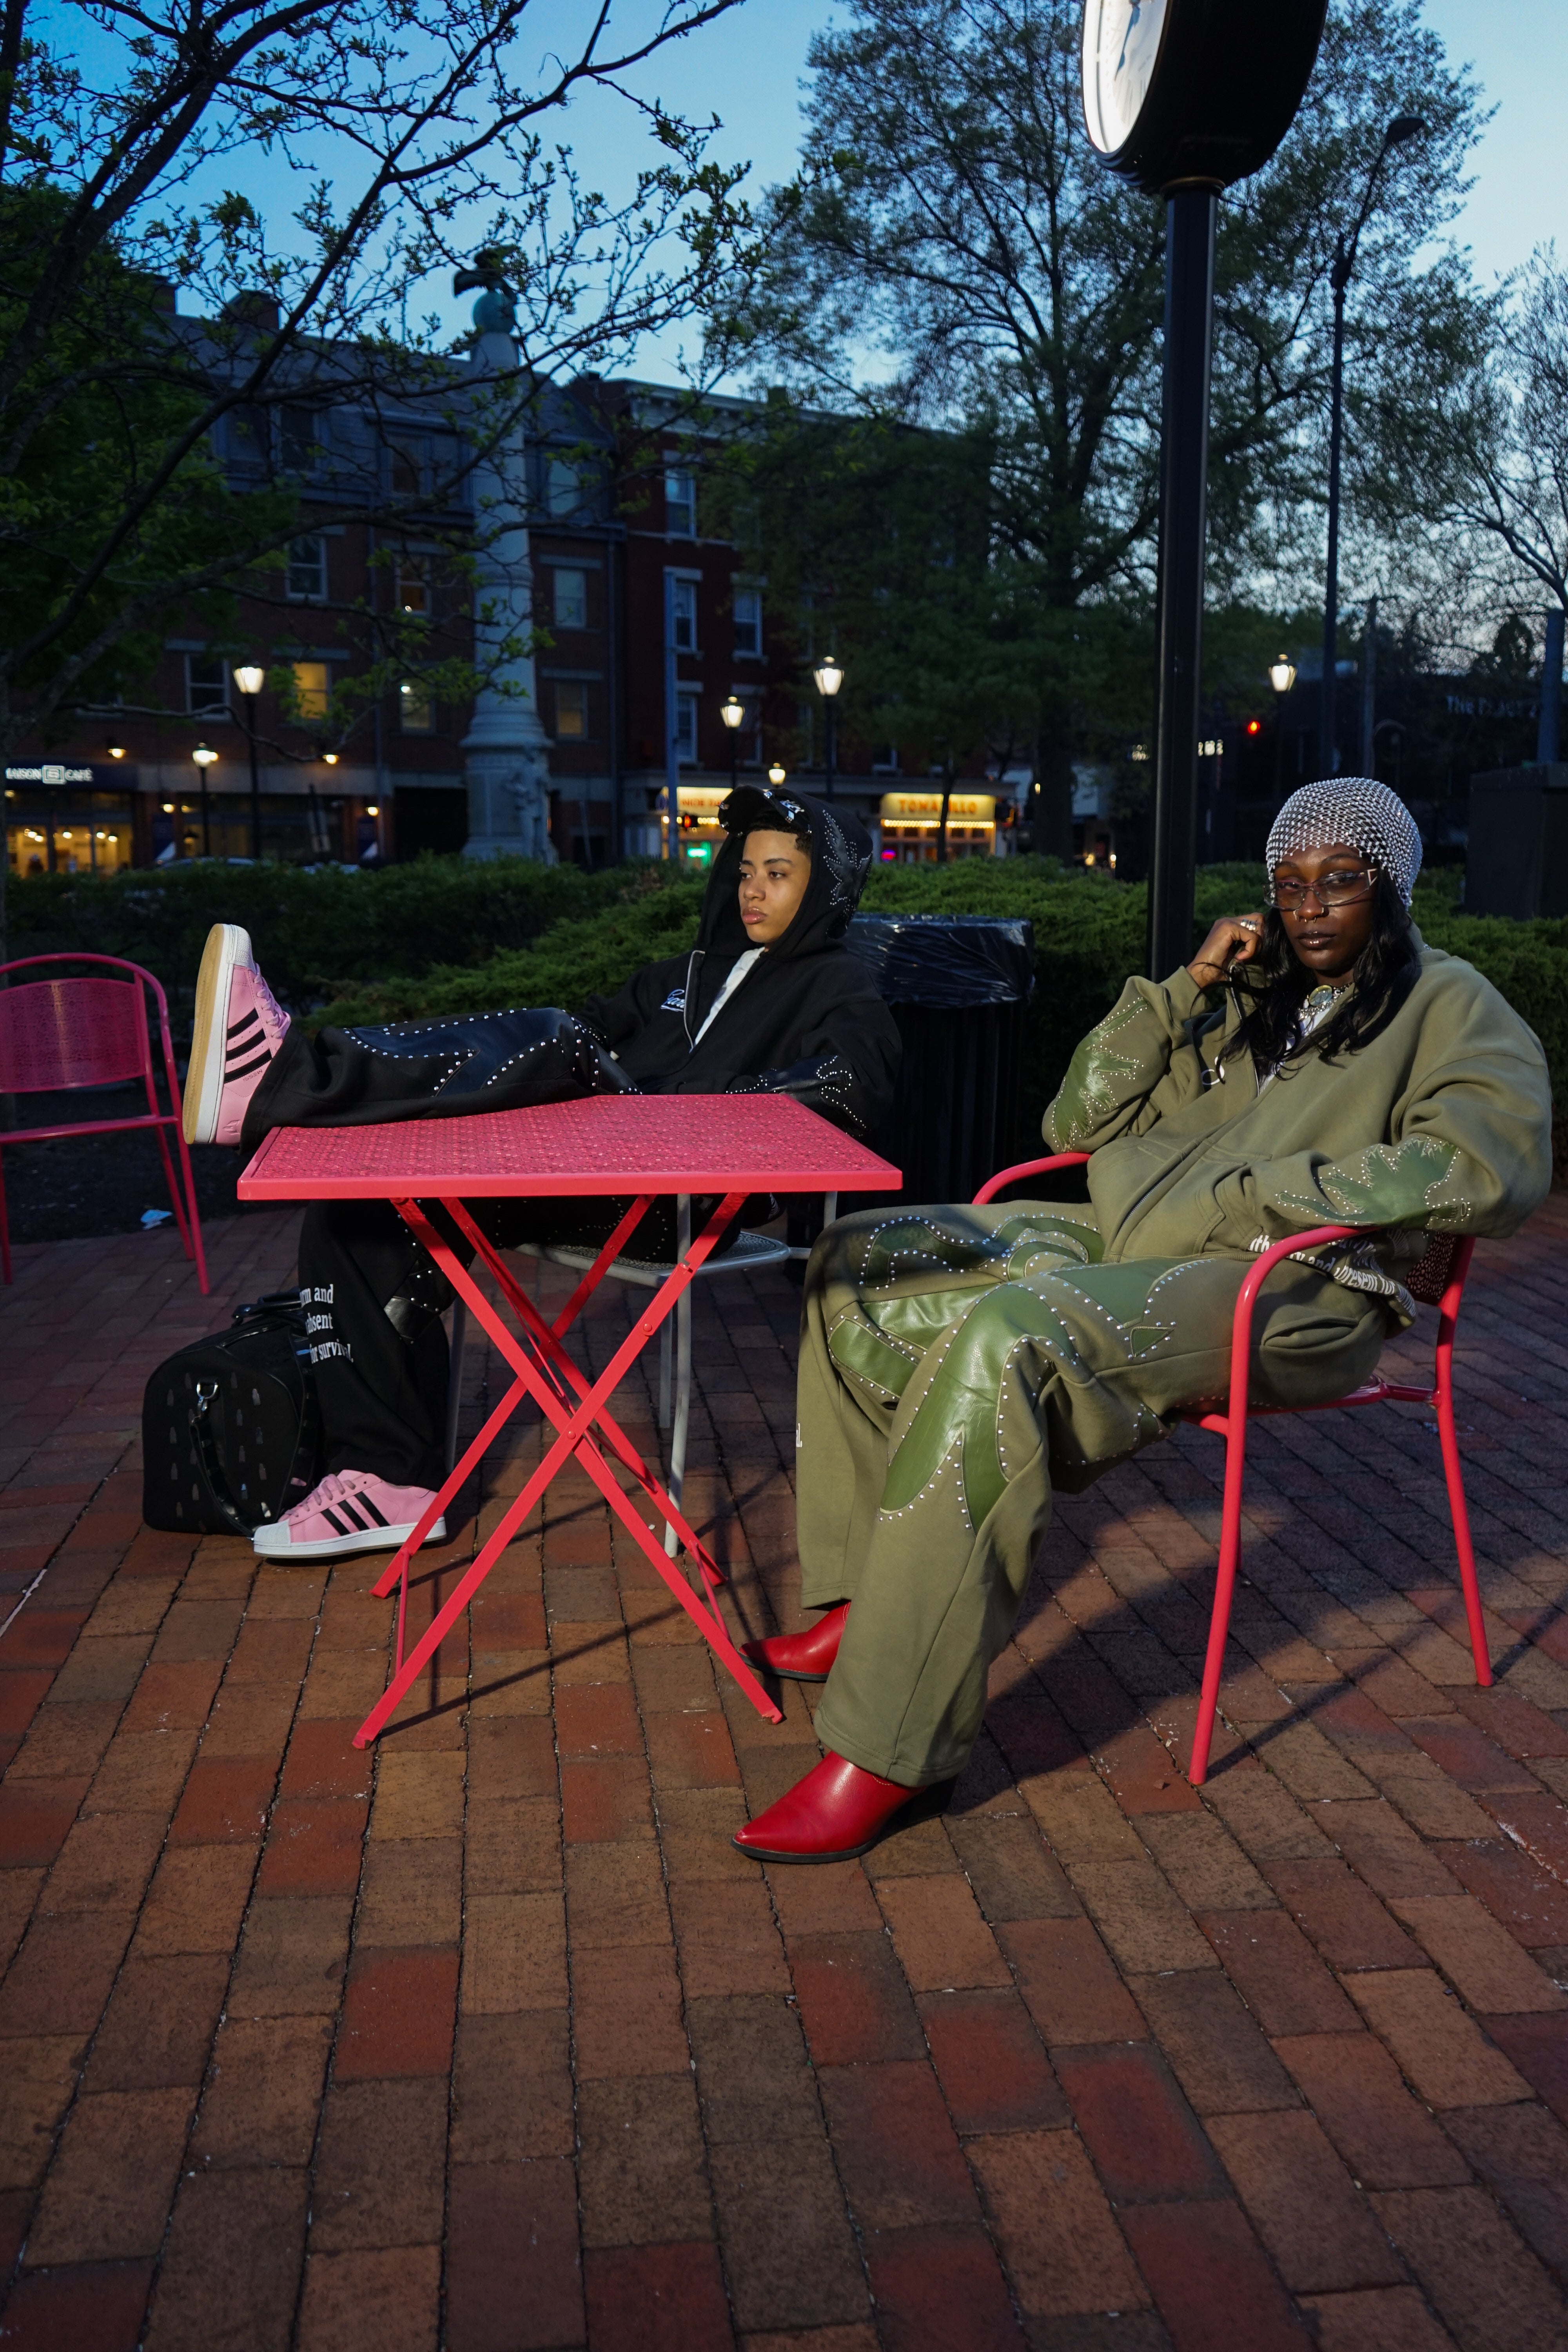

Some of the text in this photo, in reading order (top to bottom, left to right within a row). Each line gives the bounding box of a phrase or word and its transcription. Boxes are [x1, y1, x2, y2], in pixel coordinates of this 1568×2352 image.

[899, 799, 977, 813] TOMAILLO
[243, 1069, 263, 1081] MESSI
[314, 1284, 334, 1304] and
